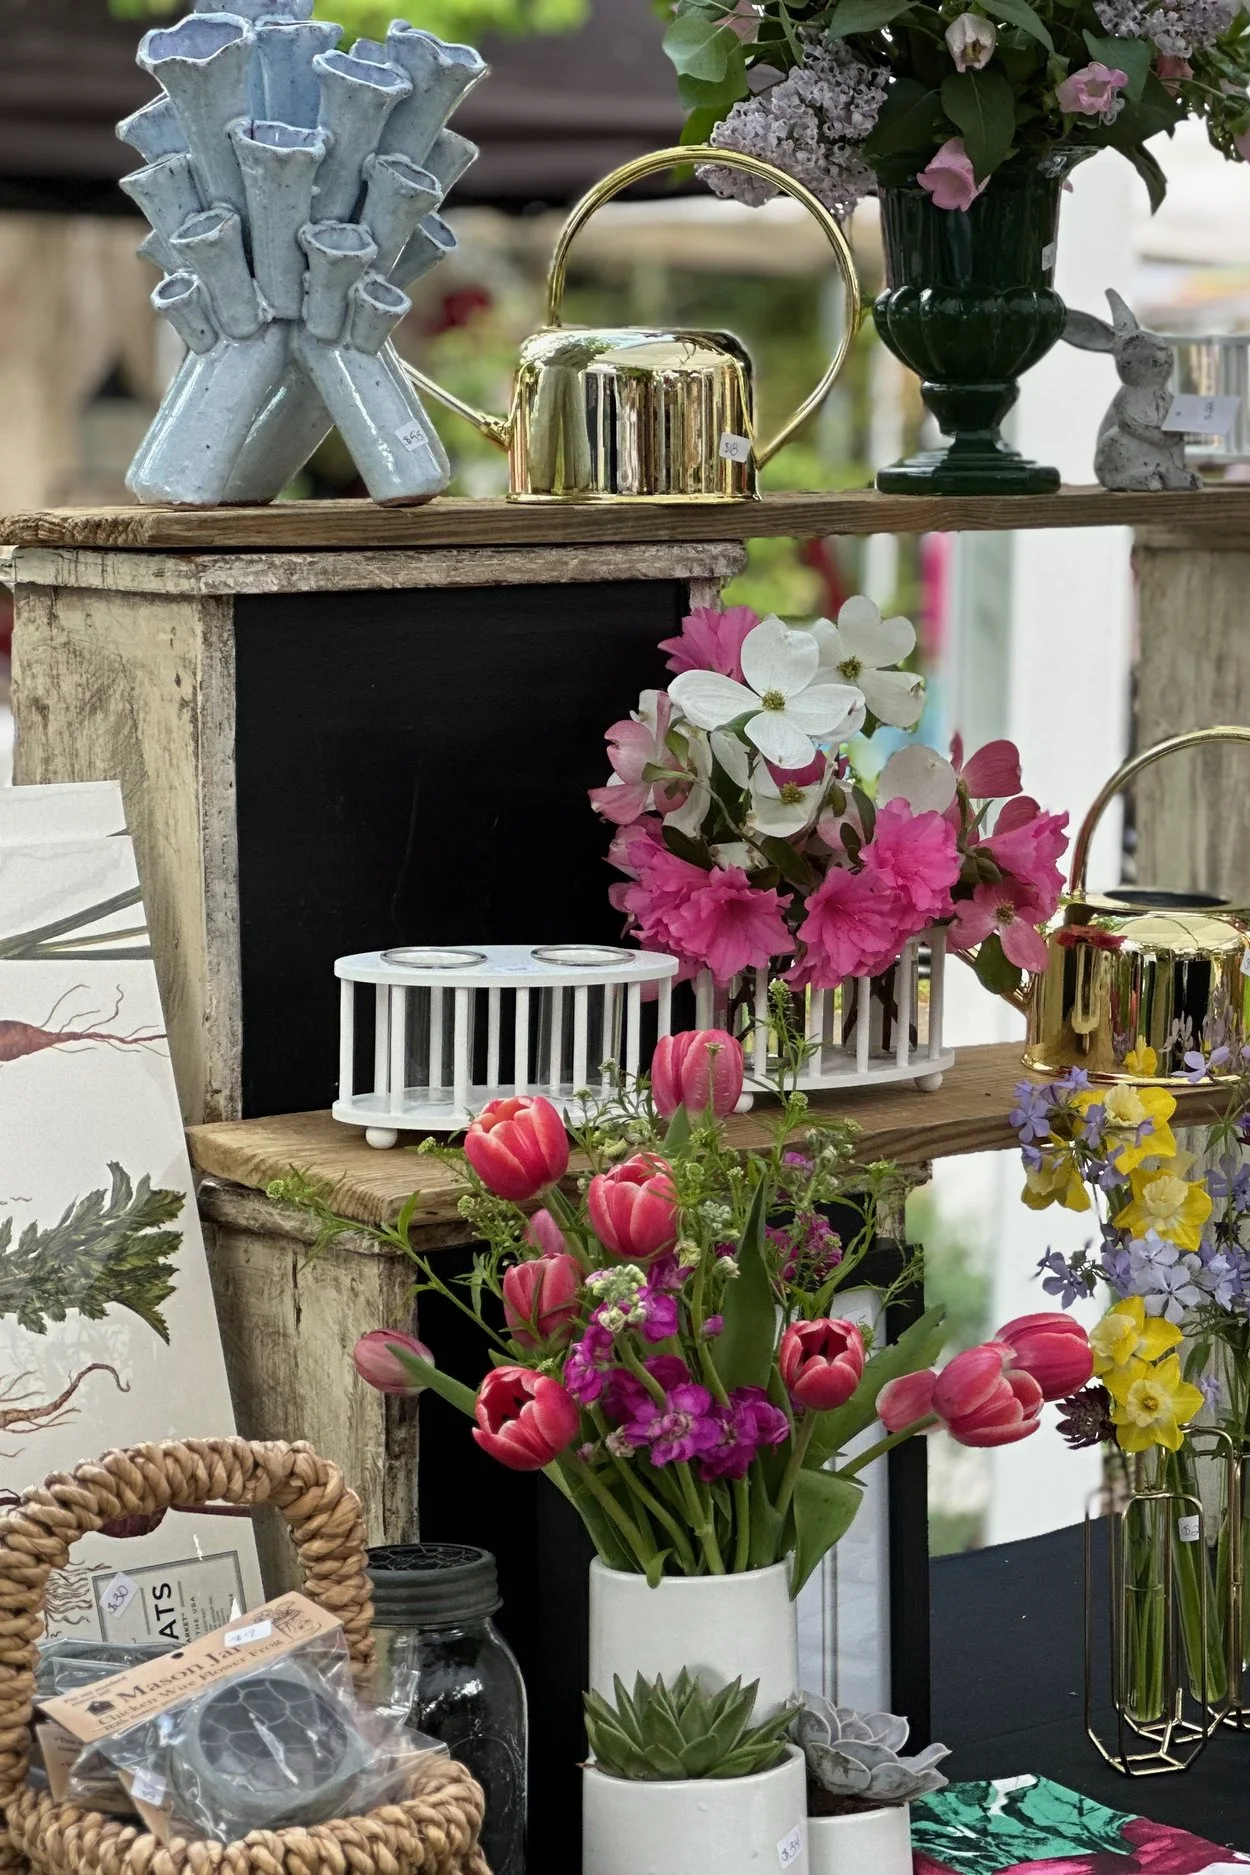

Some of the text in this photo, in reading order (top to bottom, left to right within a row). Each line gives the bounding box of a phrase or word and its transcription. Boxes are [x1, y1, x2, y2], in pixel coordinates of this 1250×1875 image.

[152, 1582, 180, 1640] ATS
[98, 1697, 158, 1727] Chicken
[157, 1679, 197, 1699] Wire
[199, 1655, 251, 1682] Flower
[117, 1661, 203, 1703] Mason
[203, 1645, 243, 1668] Jar
